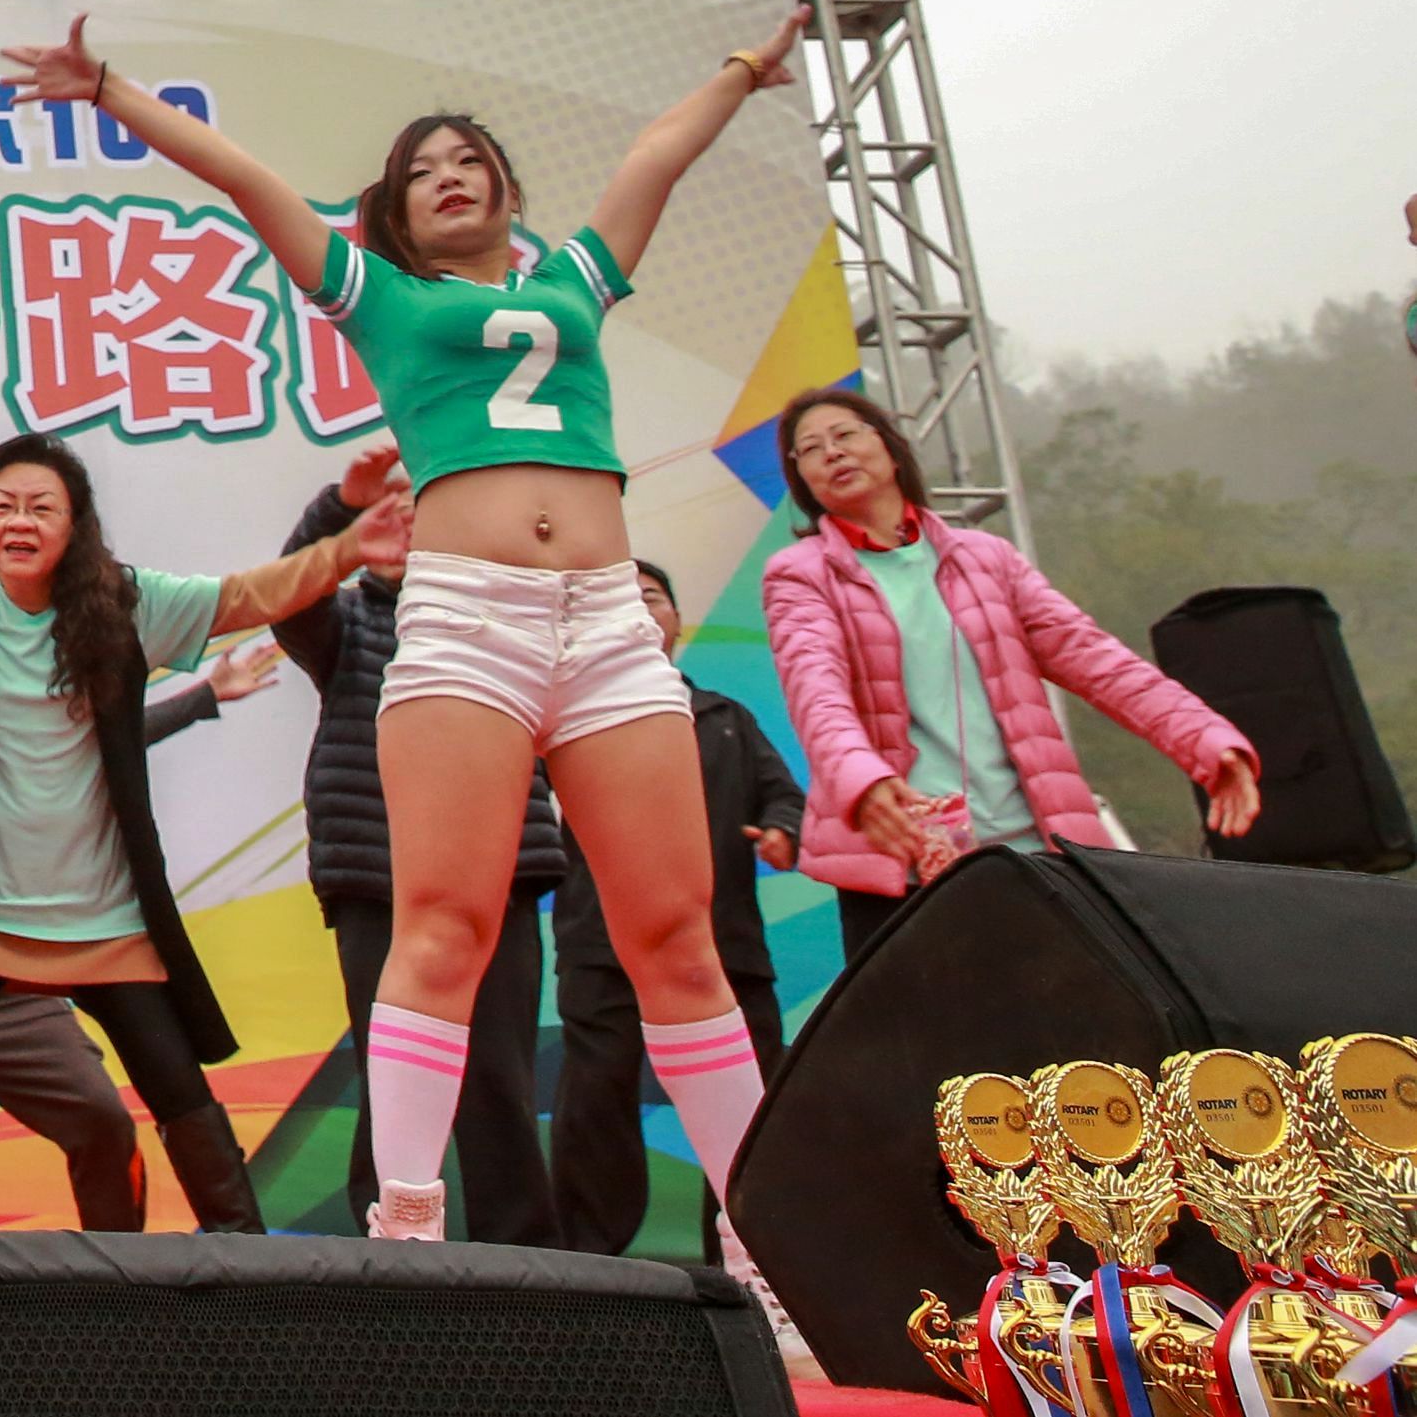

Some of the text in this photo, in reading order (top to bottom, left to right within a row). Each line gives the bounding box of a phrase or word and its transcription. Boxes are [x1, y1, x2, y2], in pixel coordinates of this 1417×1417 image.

[483, 310, 563, 432] 2
[1342, 1089, 1387, 1100] ROTARY
[1198, 1099, 1237, 1110] ROTARY
[1351, 1104, 1384, 1113] D3501
[1062, 1105, 1099, 1116] ROTARY
[967, 1116, 999, 1125] ROTARY
[1206, 1114, 1235, 1122] D3501
